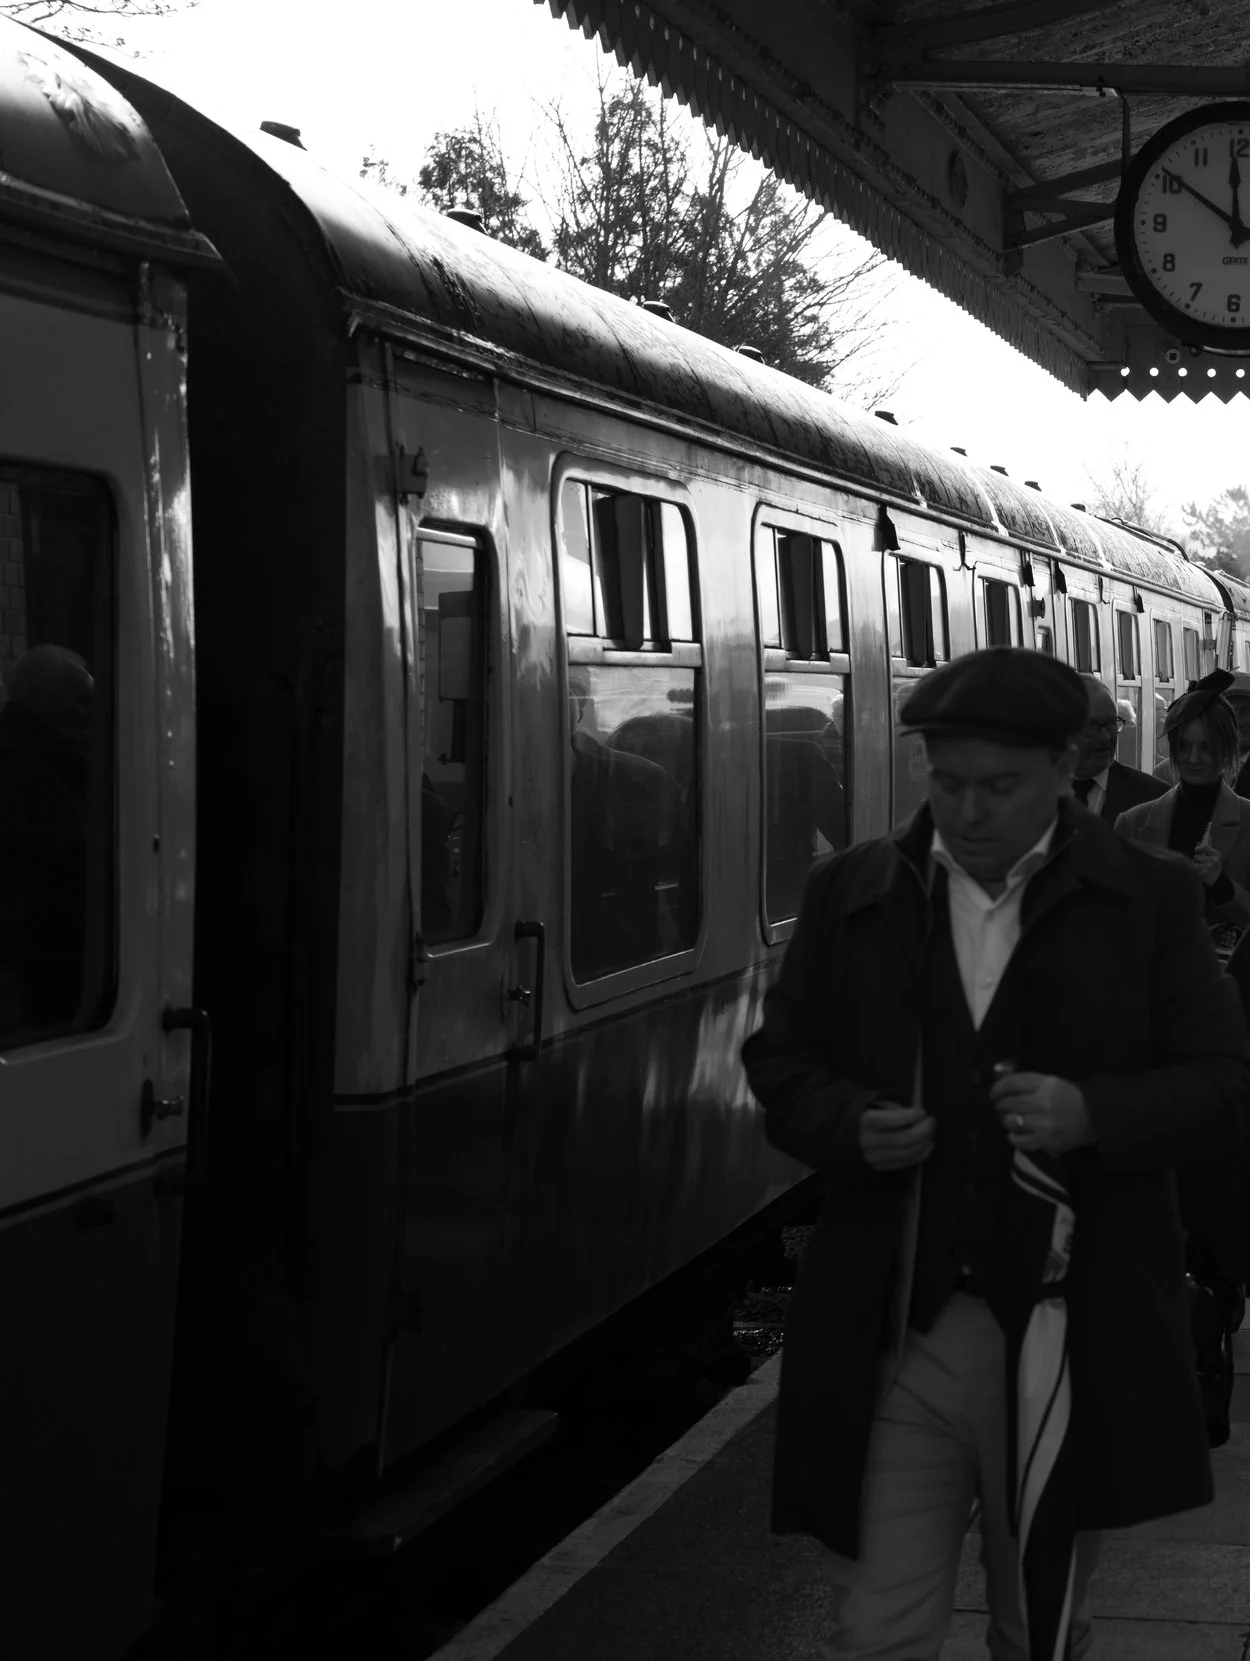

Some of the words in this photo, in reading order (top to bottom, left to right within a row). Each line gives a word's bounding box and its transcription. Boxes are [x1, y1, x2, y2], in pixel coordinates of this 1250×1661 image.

[1194, 147, 1208, 167] 11
[1229, 138, 1250, 157] 12
[1162, 175, 1183, 194] 10
[1153, 214, 1167, 233] 9
[1162, 253, 1176, 272] 8
[1189, 282, 1203, 301] 7
[1226, 294, 1241, 313] 6
